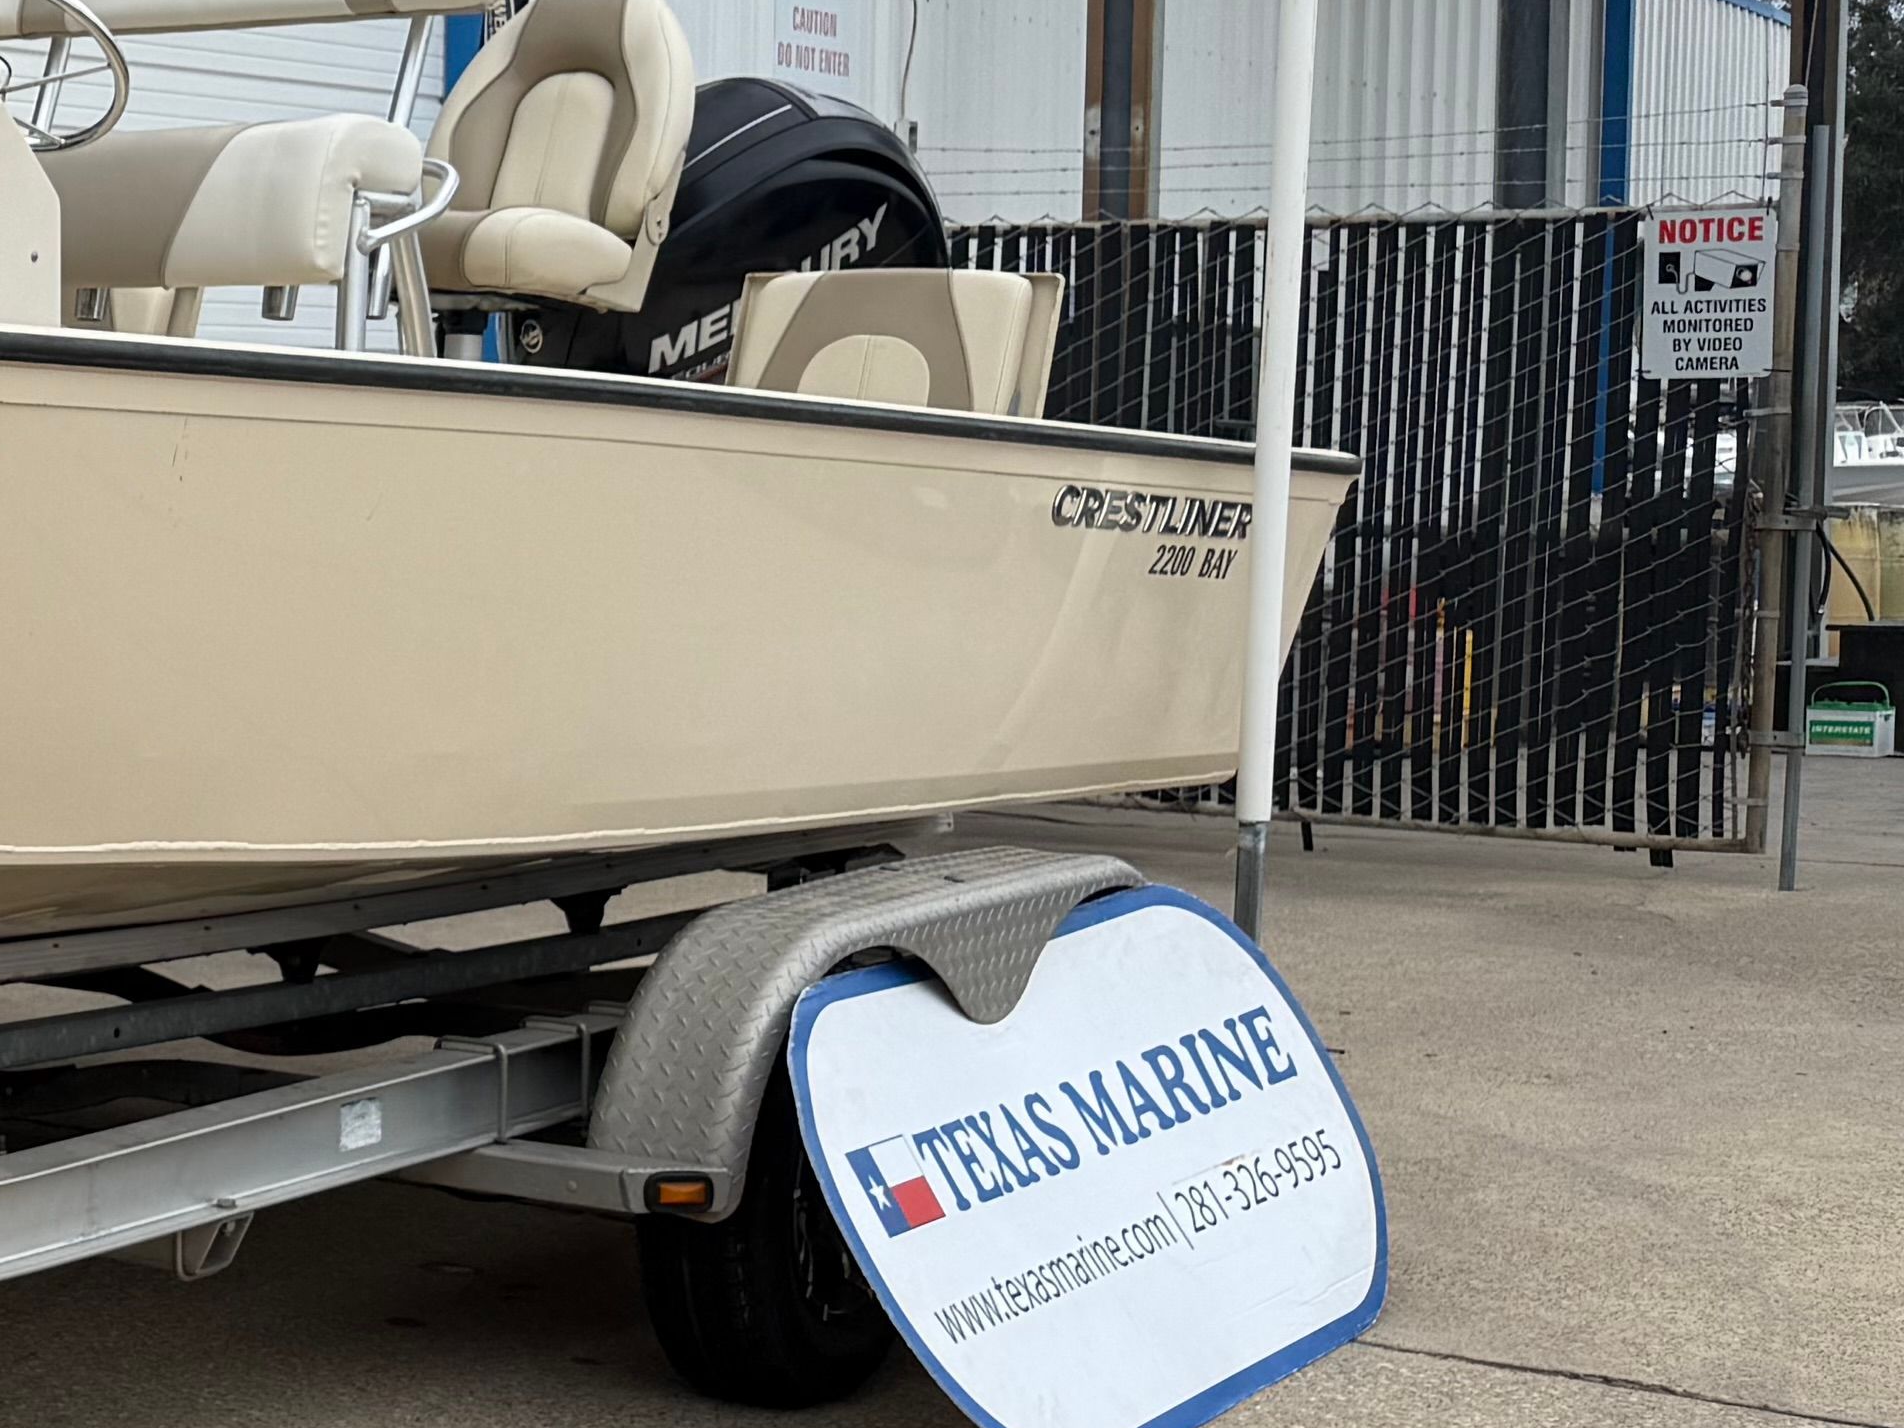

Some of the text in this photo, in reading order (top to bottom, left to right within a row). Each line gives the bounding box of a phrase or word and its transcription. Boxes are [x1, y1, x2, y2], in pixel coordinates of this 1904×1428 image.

[792, 5, 837, 38] CAUTION
[777, 41, 850, 77] DO NOT ENTER
[1658, 216, 1764, 244] NOTICE
[1651, 298, 1767, 315] ALL ACTIVITIES
[1662, 317, 1754, 334] MONITORED
[1672, 336, 1743, 352] BY VIDEO
[1674, 355, 1740, 372] CAMERA
[1051, 484, 1253, 540] CRESTLINER
[1148, 544, 1239, 580] 2200 BAY
[912, 1005, 1298, 1212] TEXAS MARINE
[934, 1210, 1178, 1345] www.texasmarine.com
[1174, 1127, 1342, 1234] 281-326-9595
